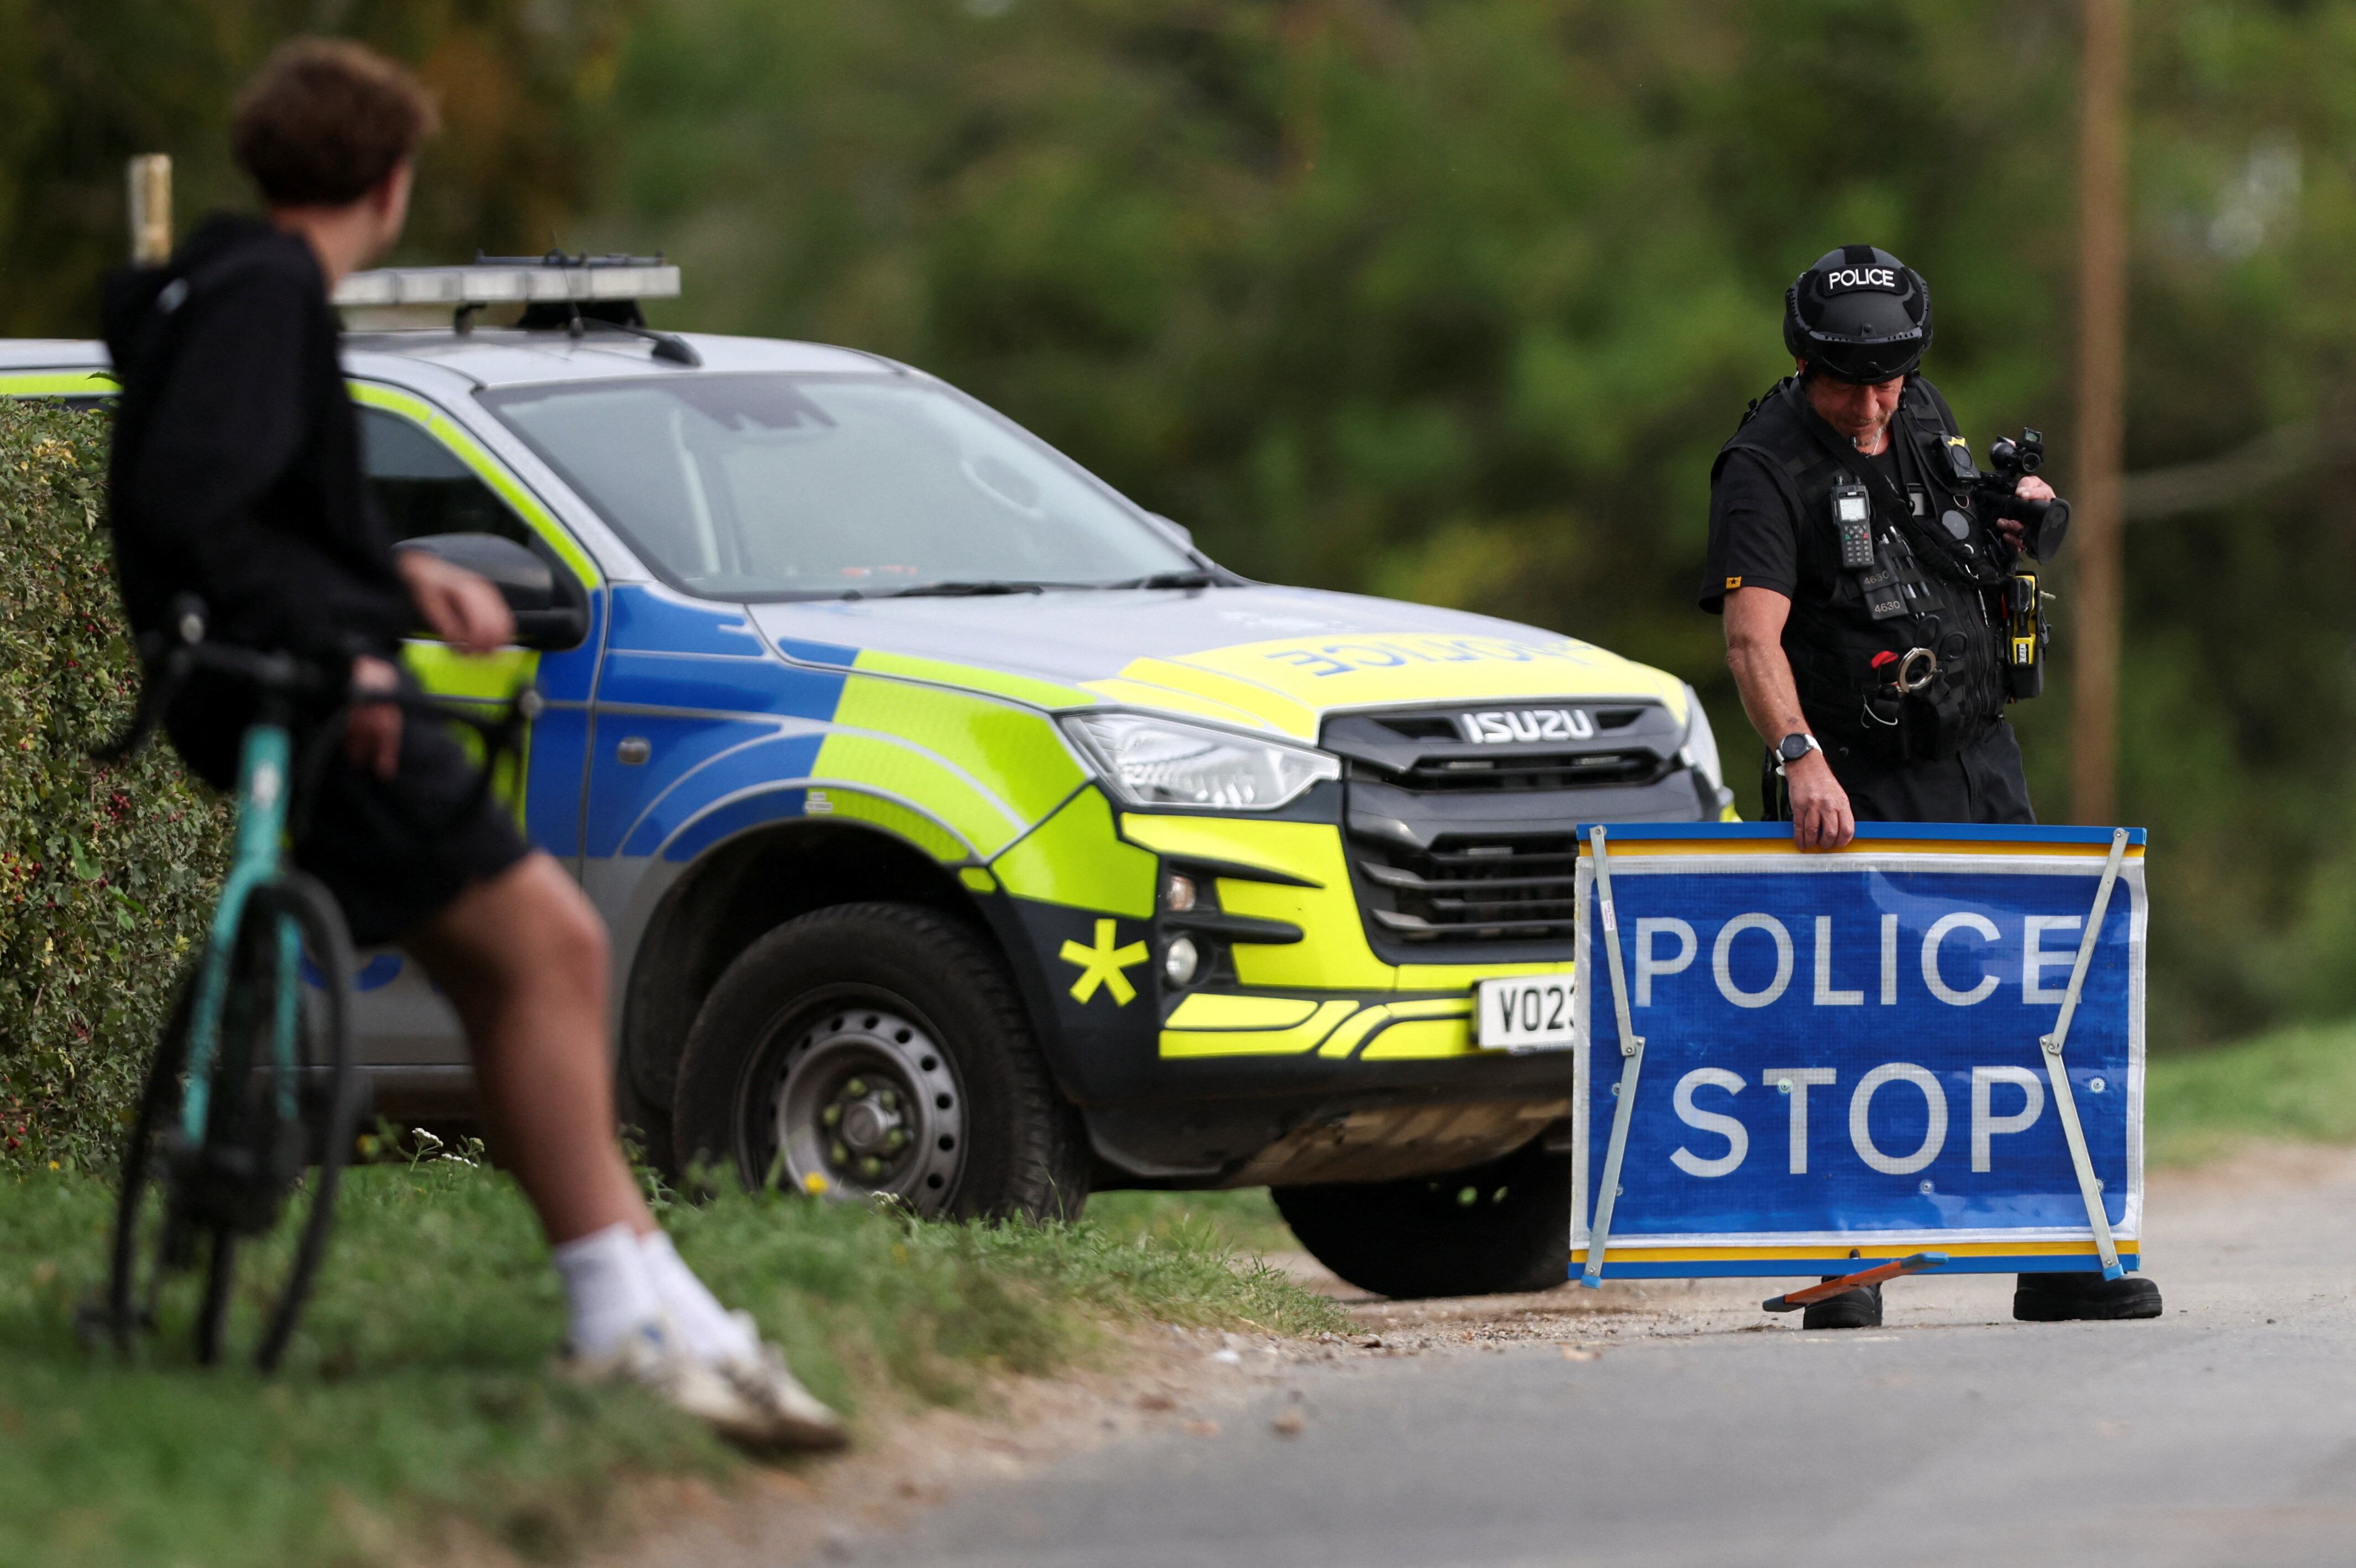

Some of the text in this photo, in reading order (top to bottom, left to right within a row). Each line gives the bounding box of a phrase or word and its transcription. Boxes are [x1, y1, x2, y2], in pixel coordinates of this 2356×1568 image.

[1829, 269, 1895, 289] POLICE
[1864, 570, 1889, 585] 4630
[1874, 601, 1900, 613] 4630
[1461, 709, 1594, 744] ISUZU
[1635, 913, 2082, 1008] POLICE
[1669, 1062, 2045, 1178] STOP
